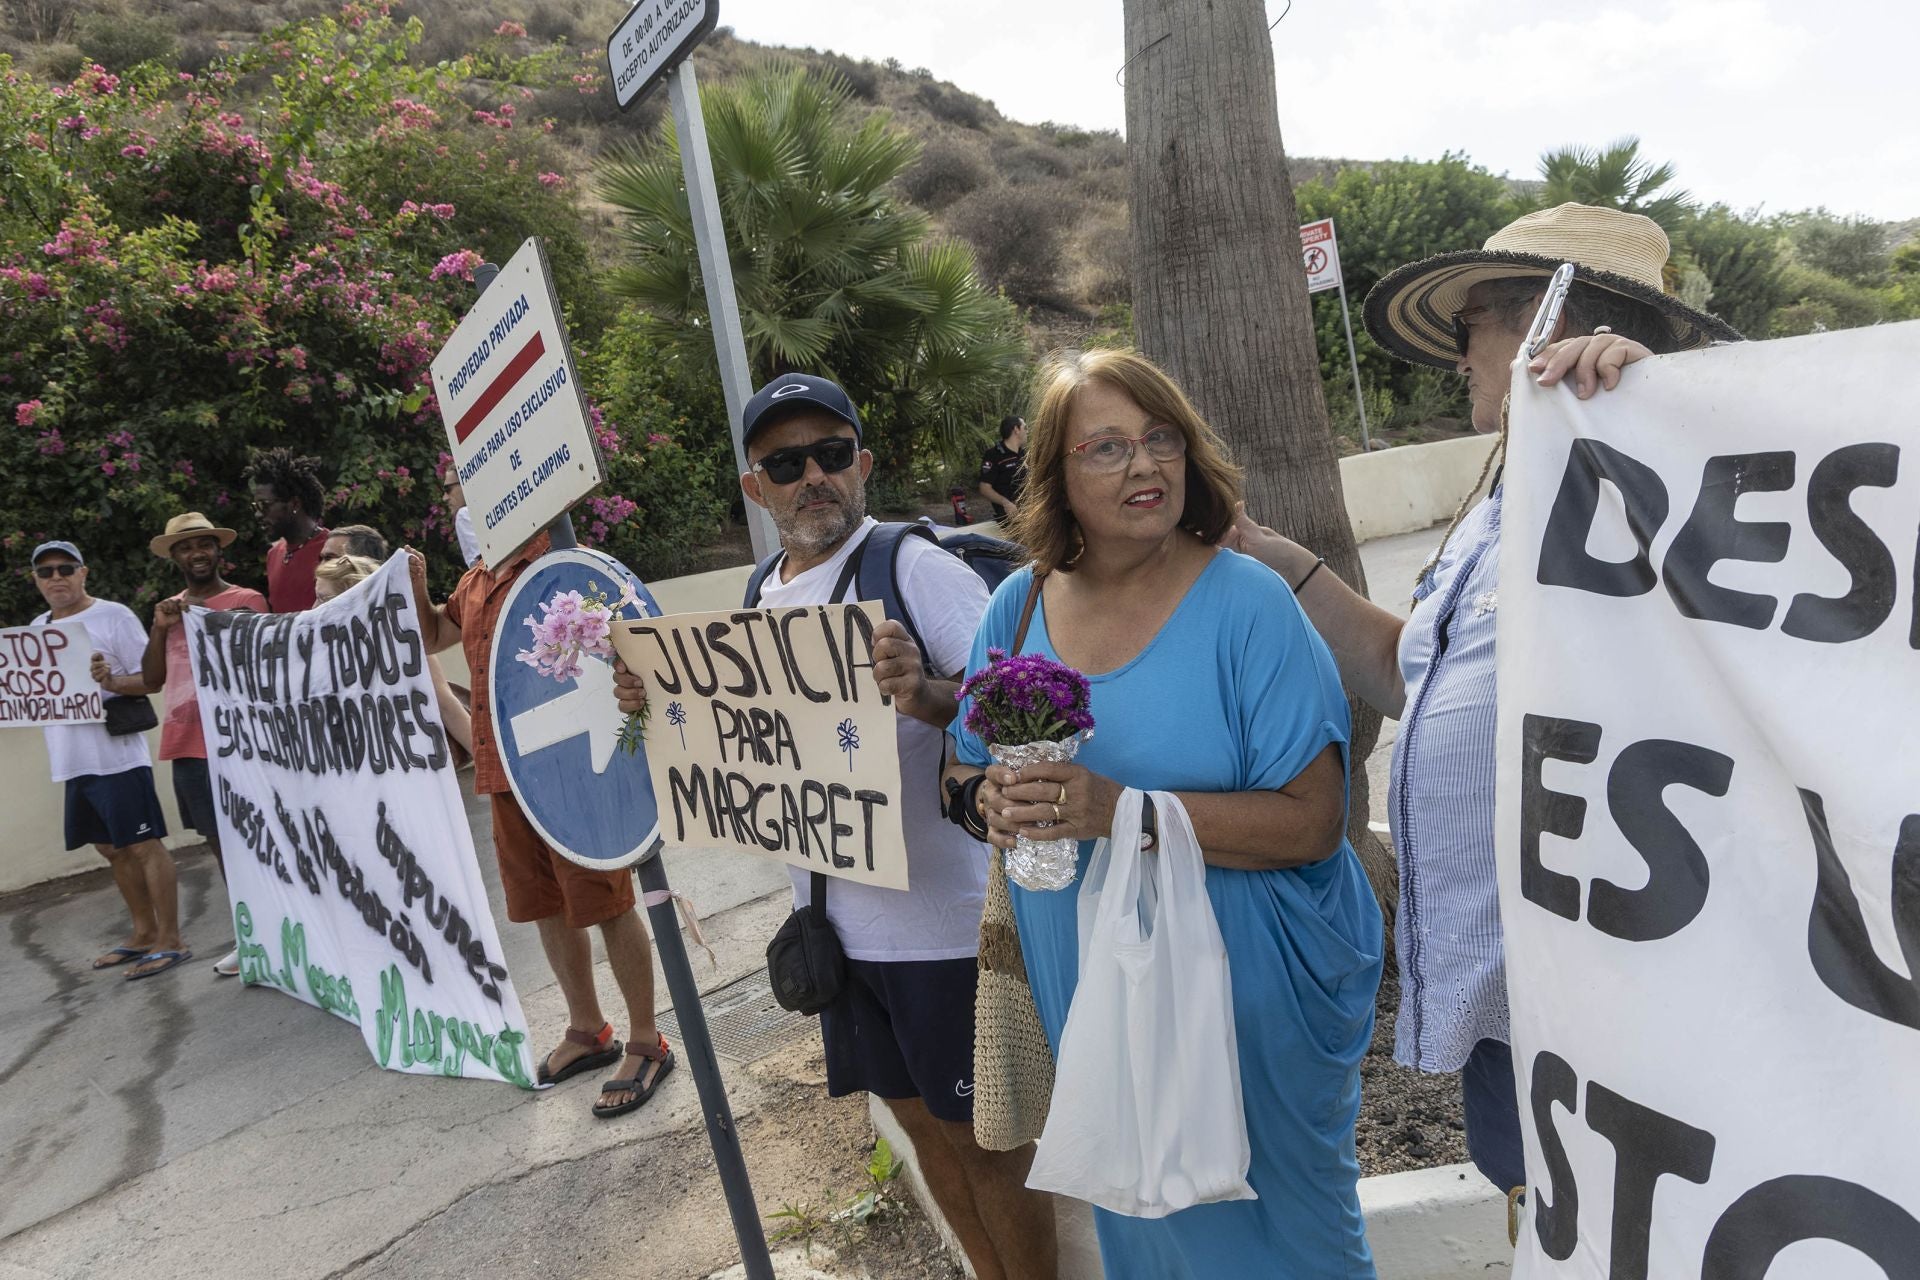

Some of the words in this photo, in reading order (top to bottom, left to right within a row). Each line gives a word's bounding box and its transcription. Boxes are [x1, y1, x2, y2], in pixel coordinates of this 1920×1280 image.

[617, 49, 648, 91] EXCEPTO
[622, 37, 633, 58] DE
[634, 14, 653, 43] 00:00
[656, 4, 662, 21] A
[1301, 232, 1328, 245] OPERTY
[448, 340, 490, 401] PROPIEDAD
[489, 294, 530, 350] PRIVADA
[459, 447, 488, 486] PARKING
[486, 428, 507, 457] PARA
[505, 411, 522, 437] USO
[521, 366, 567, 422] EXCLUSIVO
[509, 449, 523, 471] DE
[485, 490, 518, 530] CLIENTES
[518, 478, 533, 502] DEL
[532, 443, 571, 488] CAMPING
[1536, 437, 1920, 649] DES
[320, 593, 422, 692] TODOS
[0, 692, 101, 721] INMOBILIARIO
[215, 705, 253, 760] SUS
[248, 691, 448, 775] COLABORADORES
[711, 700, 801, 771] PARA
[668, 763, 888, 872] MARGARET
[1521, 713, 1735, 942] ES
